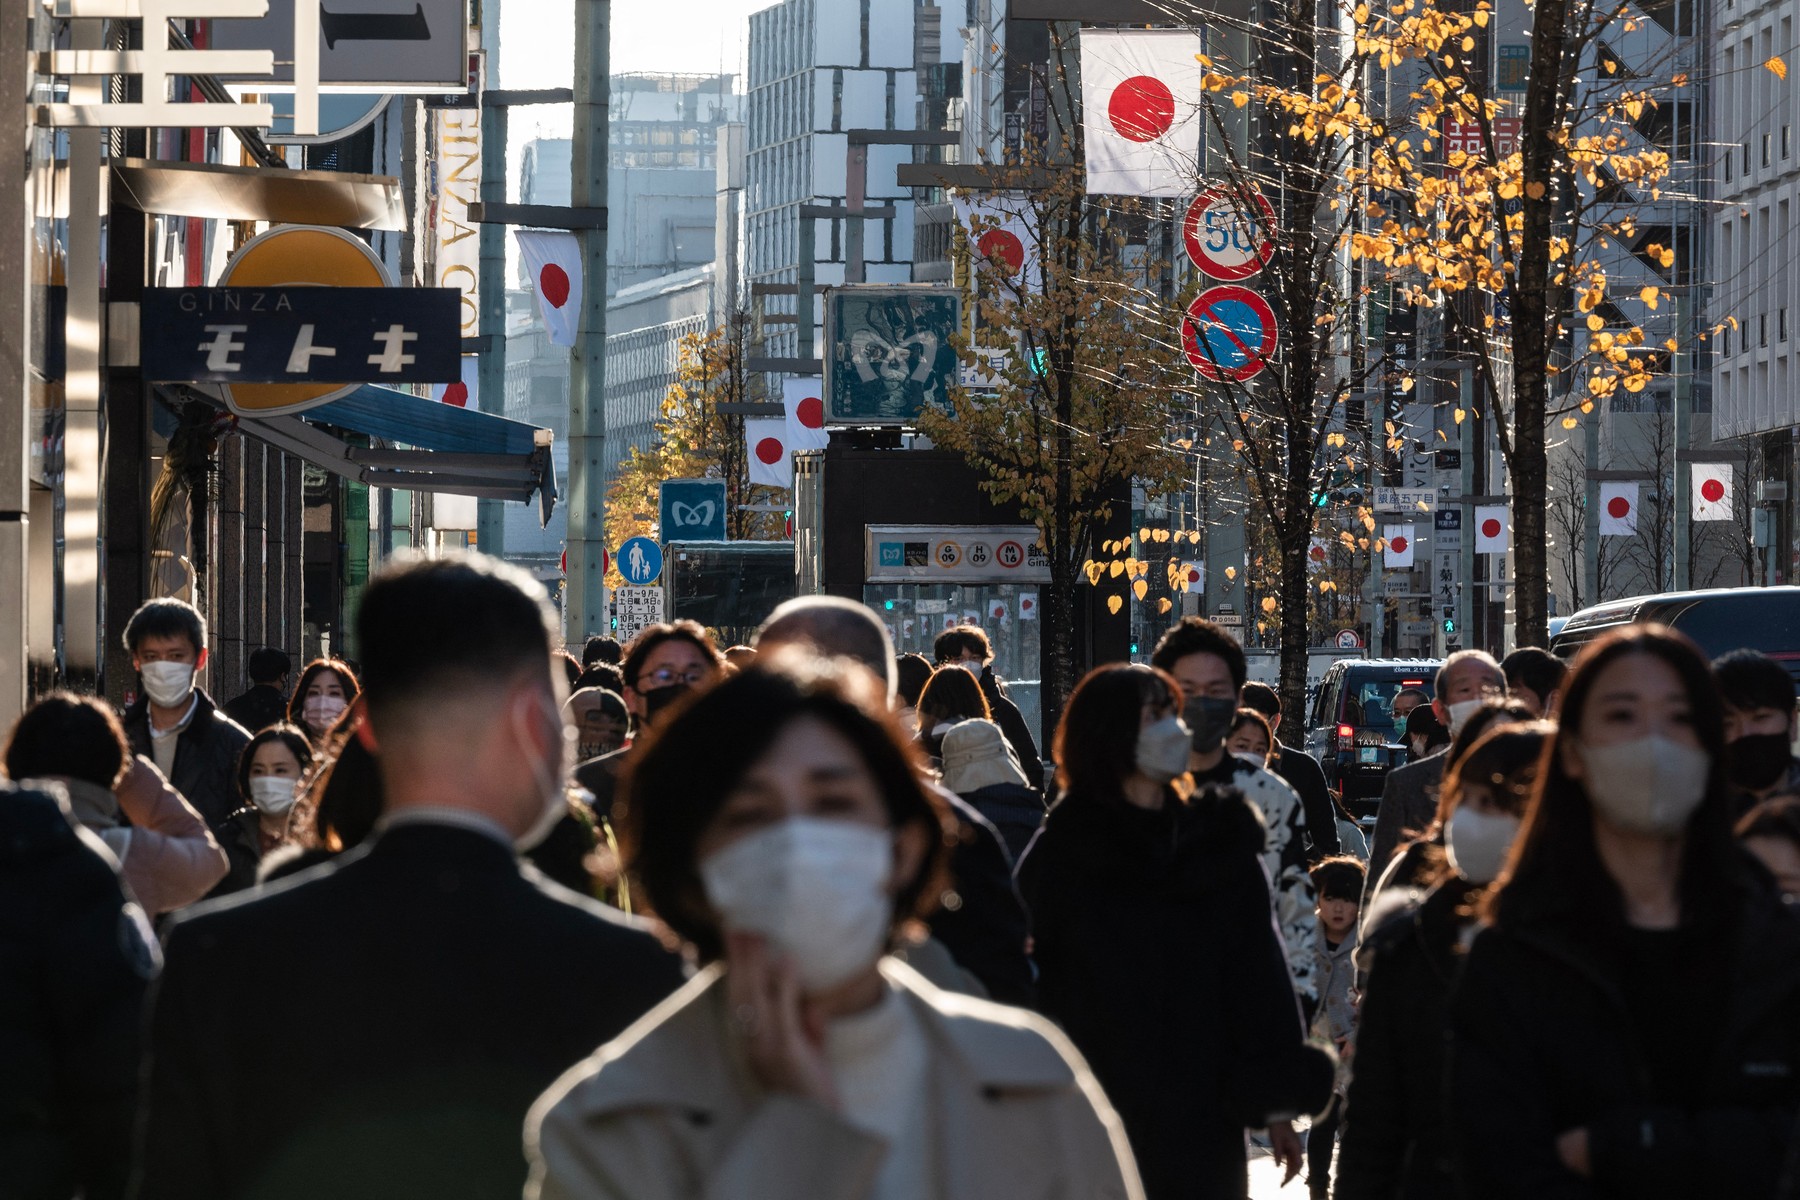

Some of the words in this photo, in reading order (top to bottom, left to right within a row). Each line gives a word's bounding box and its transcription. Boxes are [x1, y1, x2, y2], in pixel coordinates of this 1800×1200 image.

[444, 95, 459, 104] 6F
[1206, 211, 1257, 253] 50
[179, 294, 293, 312] GINZA
[197, 324, 419, 373] モトキ
[1378, 494, 1433, 504] 銀座五丁目
[941, 554, 956, 563] 09
[973, 554, 987, 562] 09
[1005, 554, 1017, 563] 16
[1028, 558, 1051, 567] Ginz
